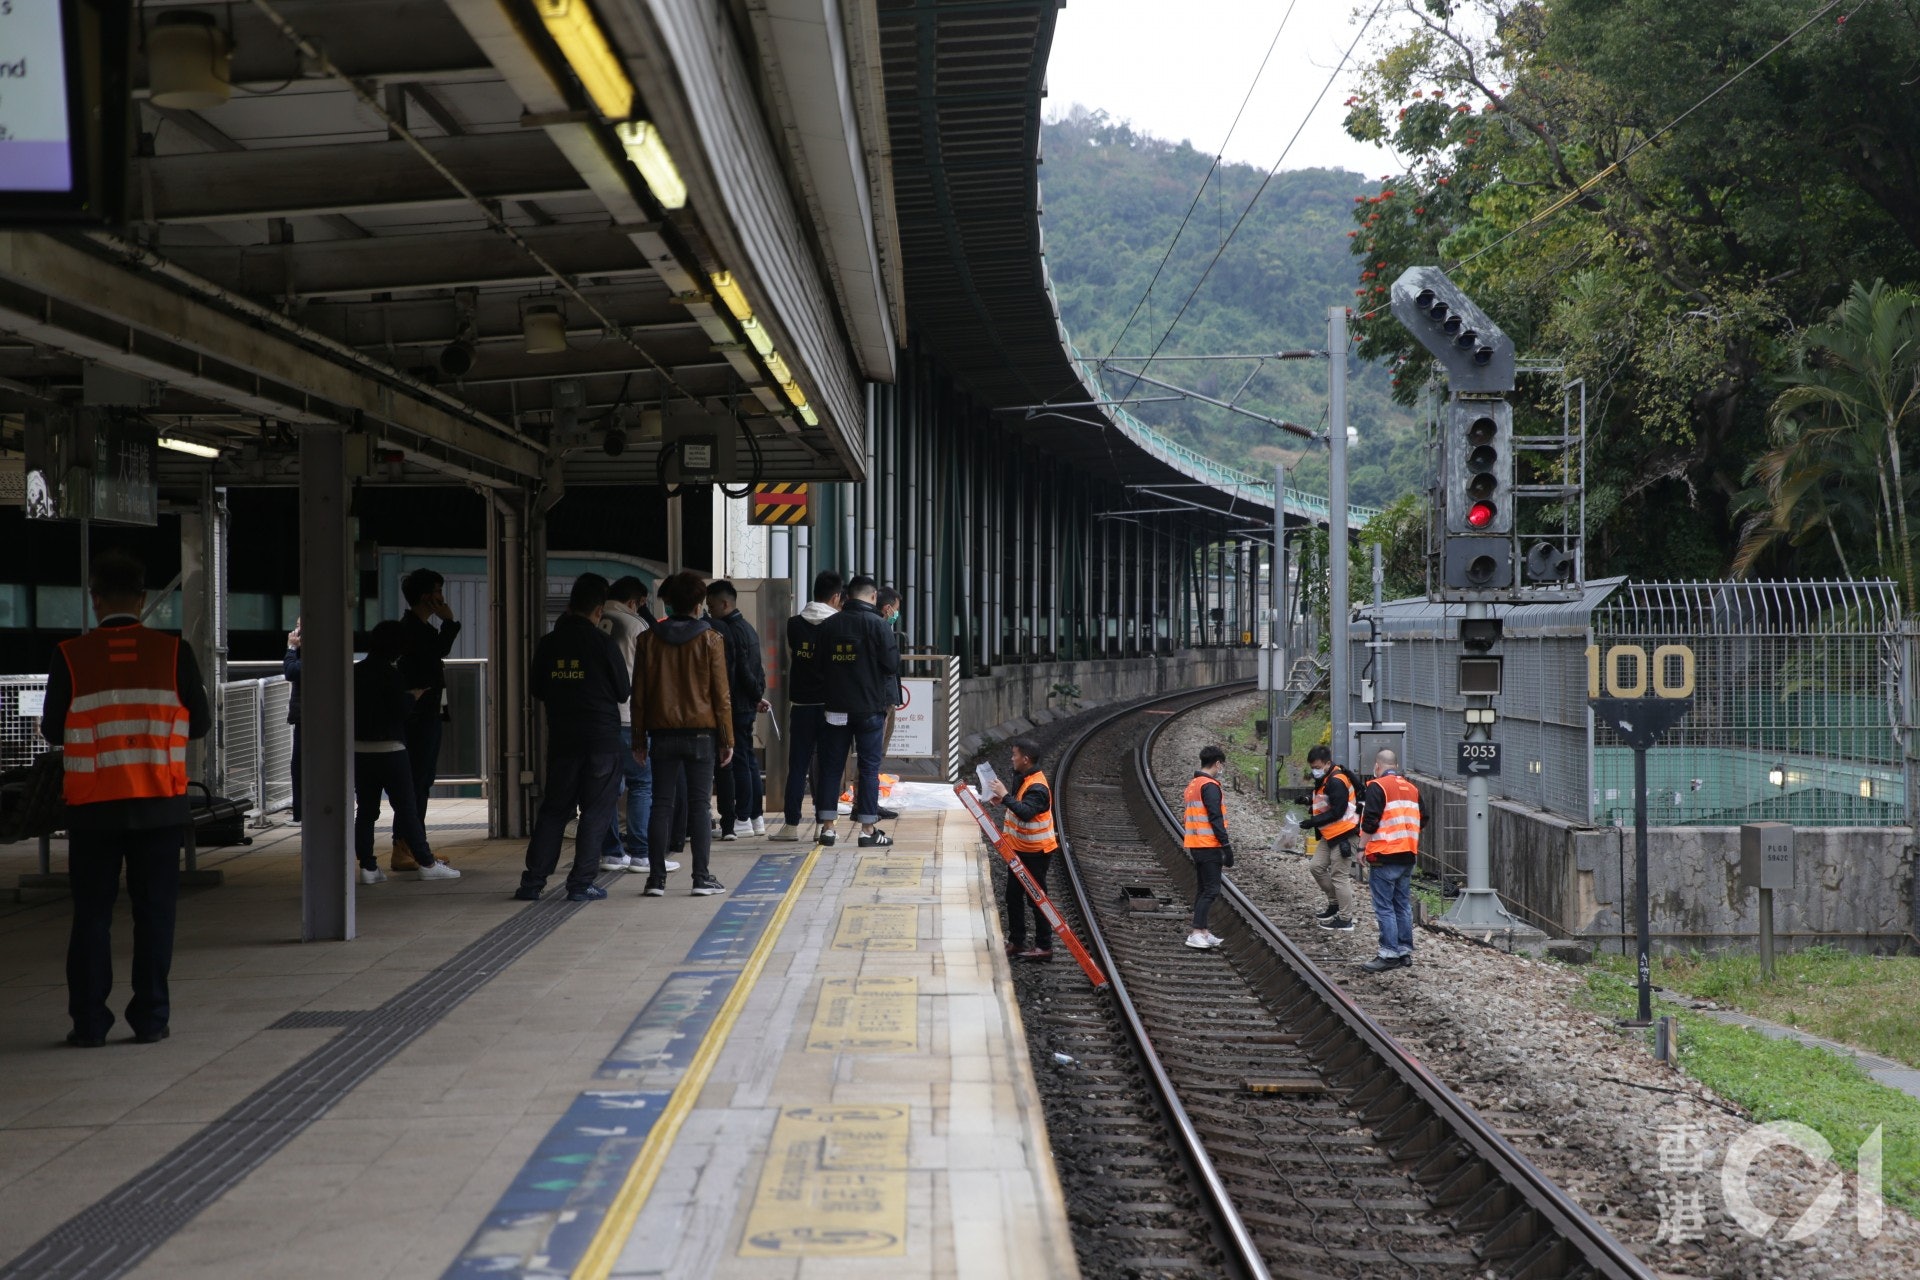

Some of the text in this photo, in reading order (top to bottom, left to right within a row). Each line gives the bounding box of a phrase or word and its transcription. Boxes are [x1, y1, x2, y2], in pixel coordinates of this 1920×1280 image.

[551, 670, 585, 679] POLICE
[1584, 645, 1695, 698] 100
[1462, 744, 1496, 758] 2053
